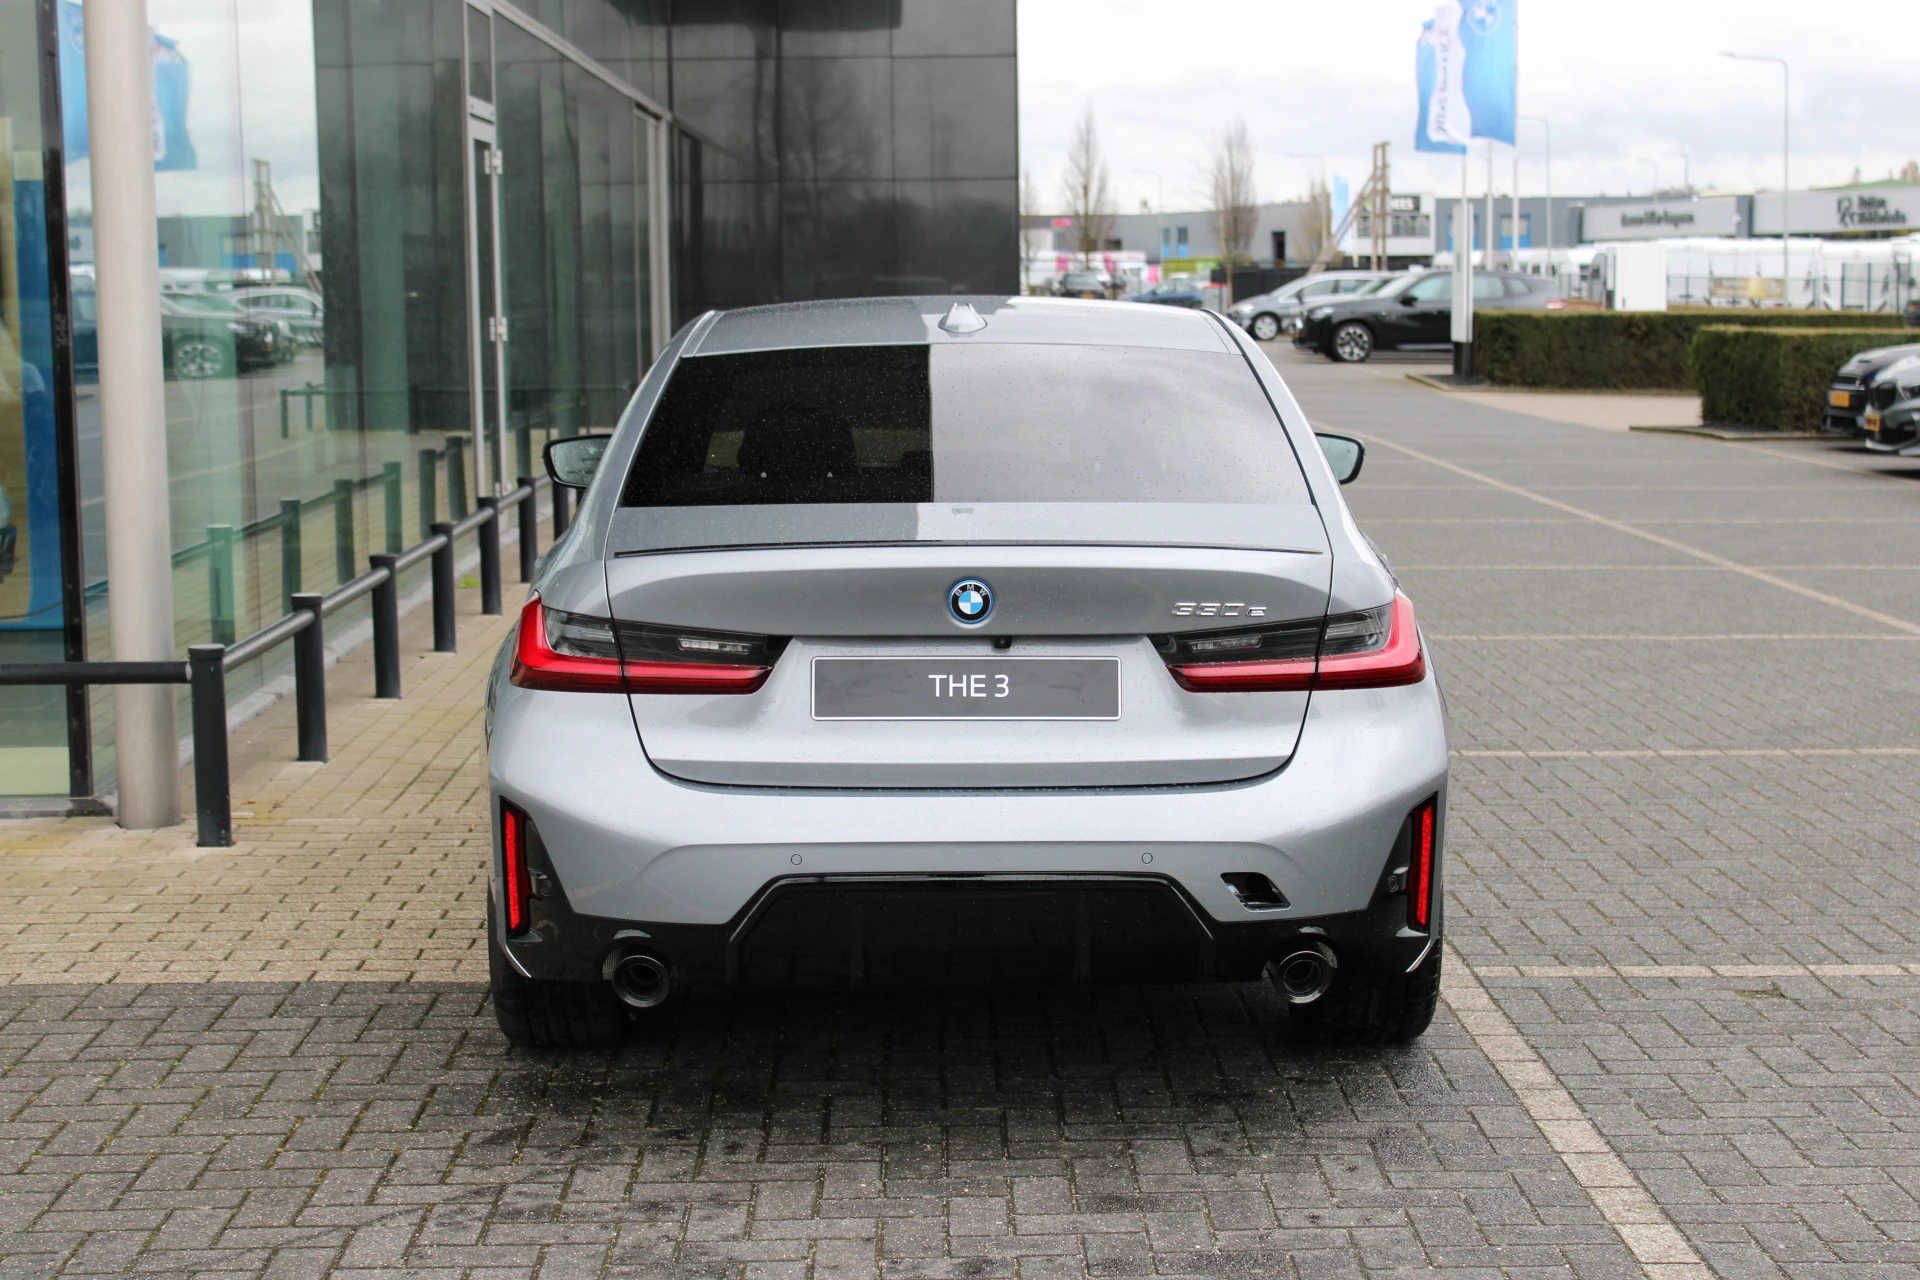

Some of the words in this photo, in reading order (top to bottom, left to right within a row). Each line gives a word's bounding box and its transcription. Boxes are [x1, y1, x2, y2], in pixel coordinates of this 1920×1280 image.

[954, 583, 988, 597] BMW
[928, 674, 987, 697] THE
[994, 674, 1010, 697] 3
